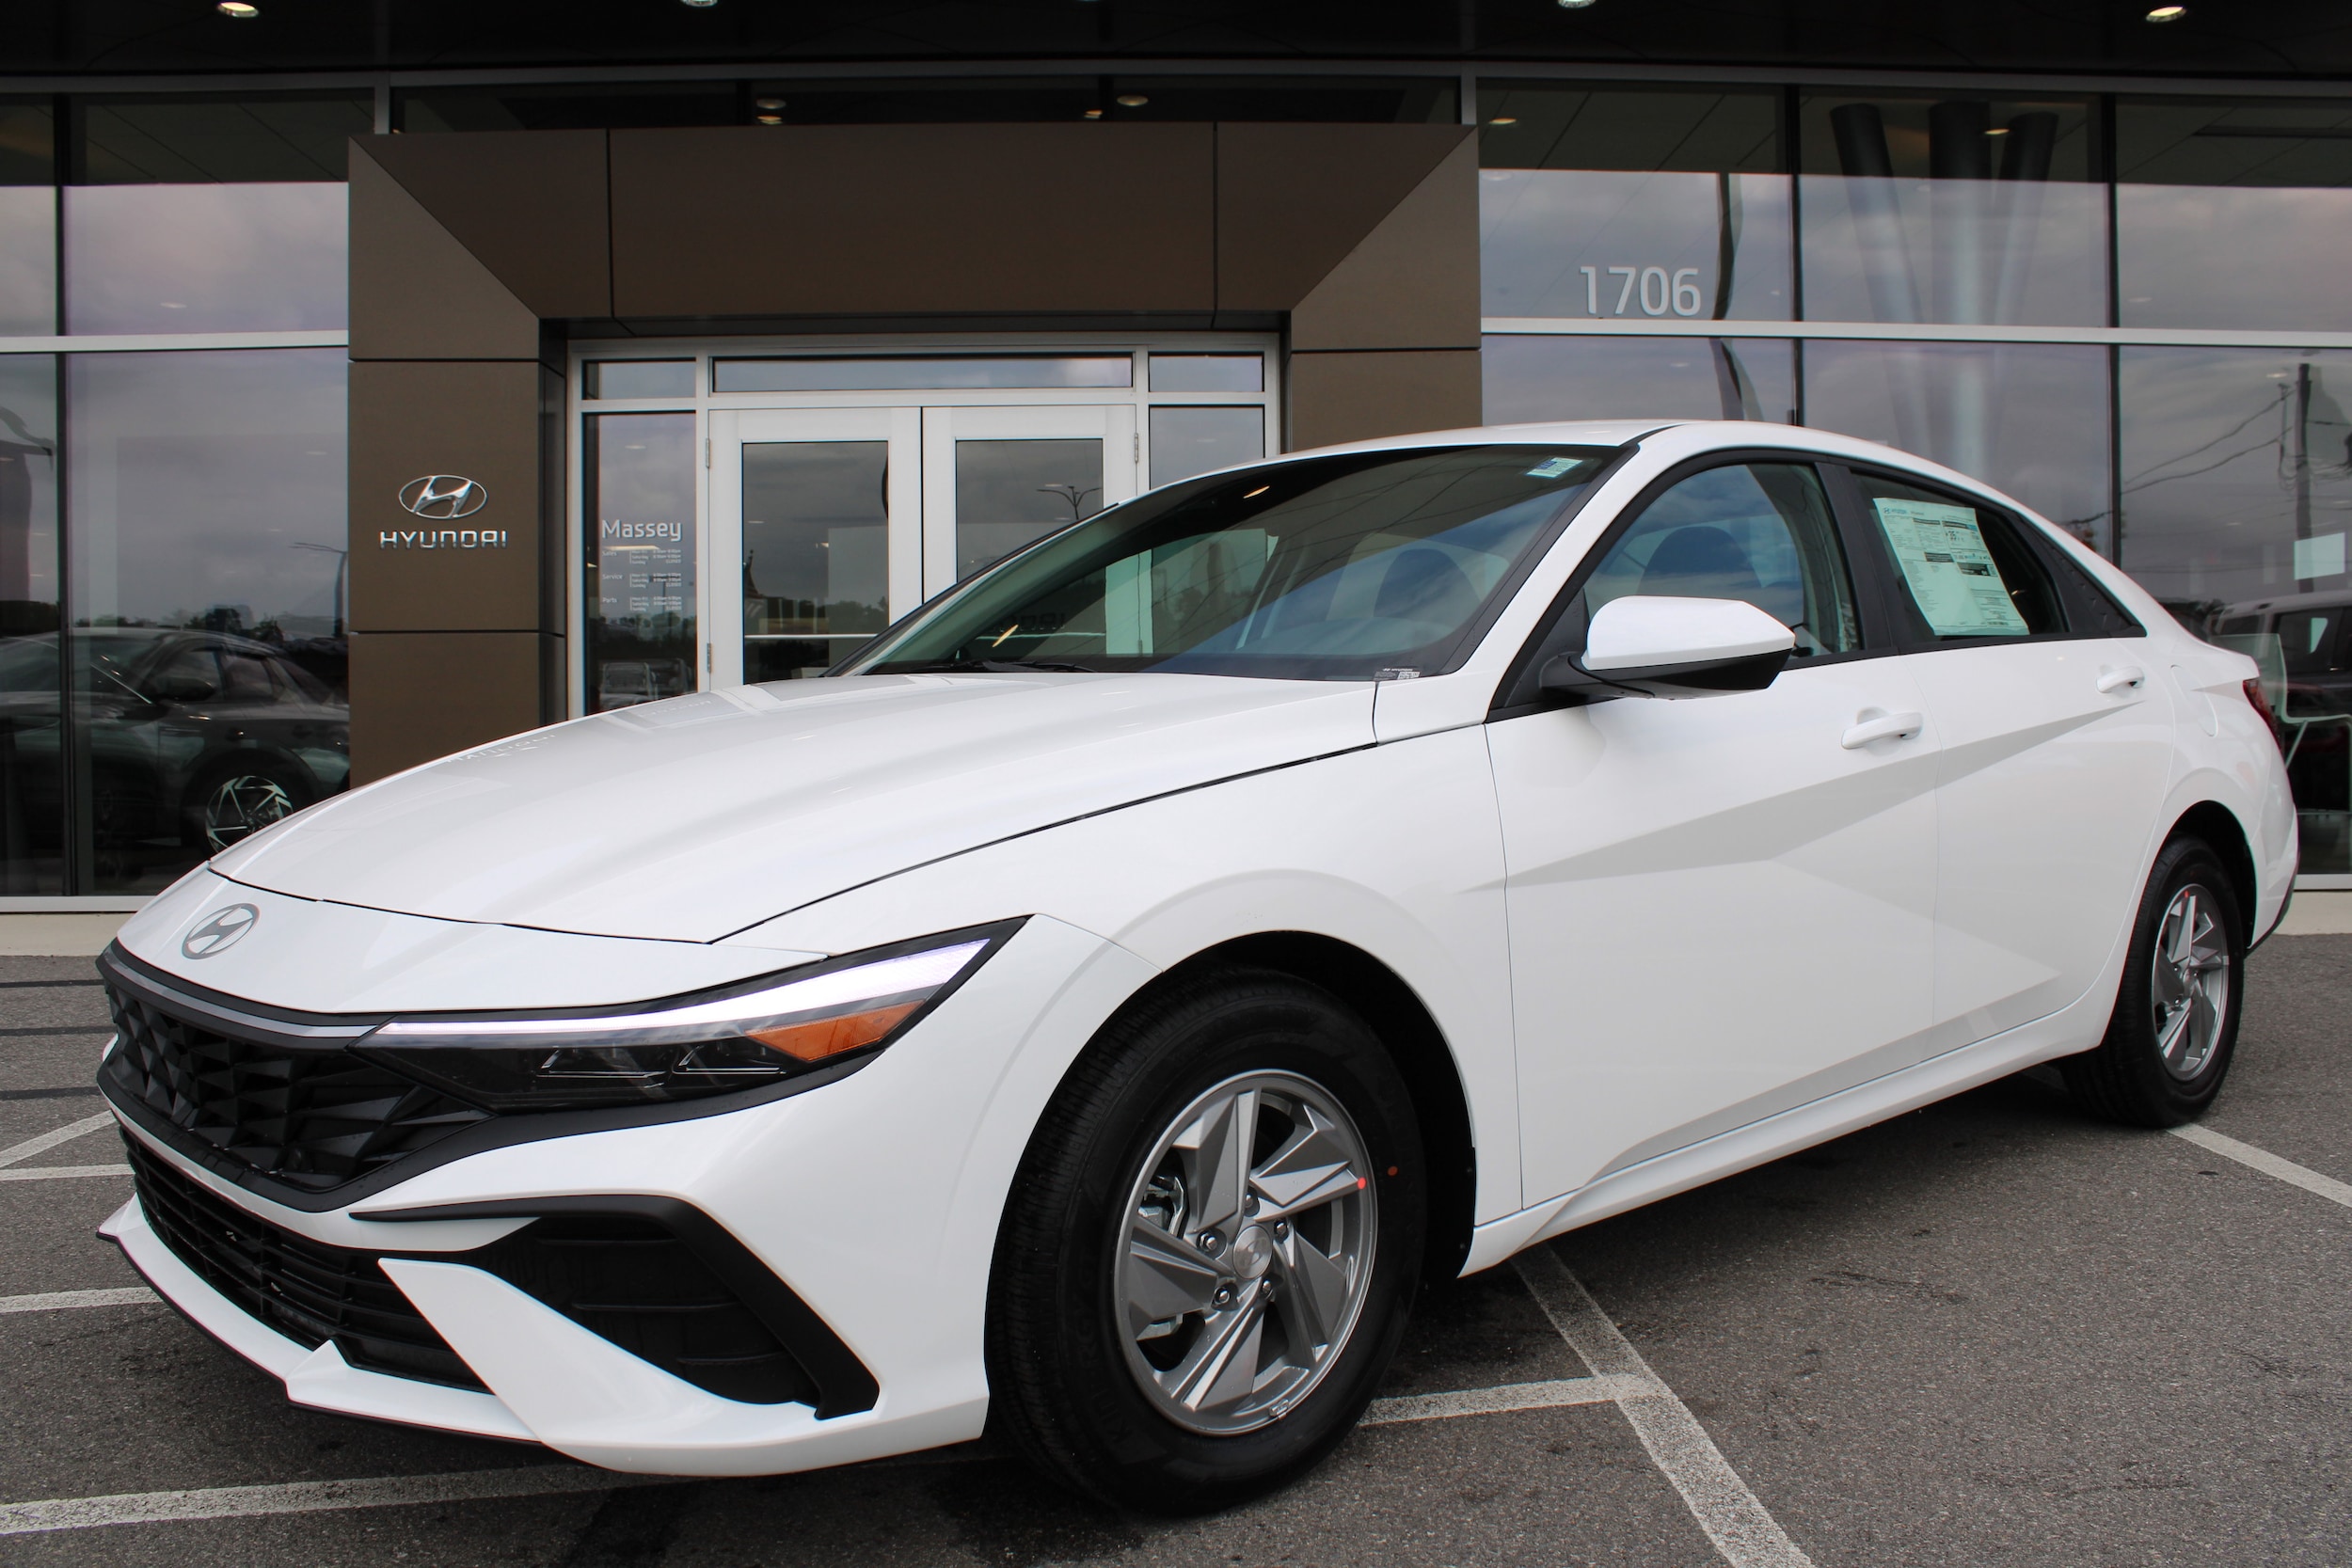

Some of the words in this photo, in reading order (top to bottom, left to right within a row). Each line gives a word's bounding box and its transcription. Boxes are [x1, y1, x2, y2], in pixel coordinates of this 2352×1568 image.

[1580, 266, 1701, 316] 1706
[379, 530, 507, 549] HYUNDAI
[601, 519, 683, 542] Massey
